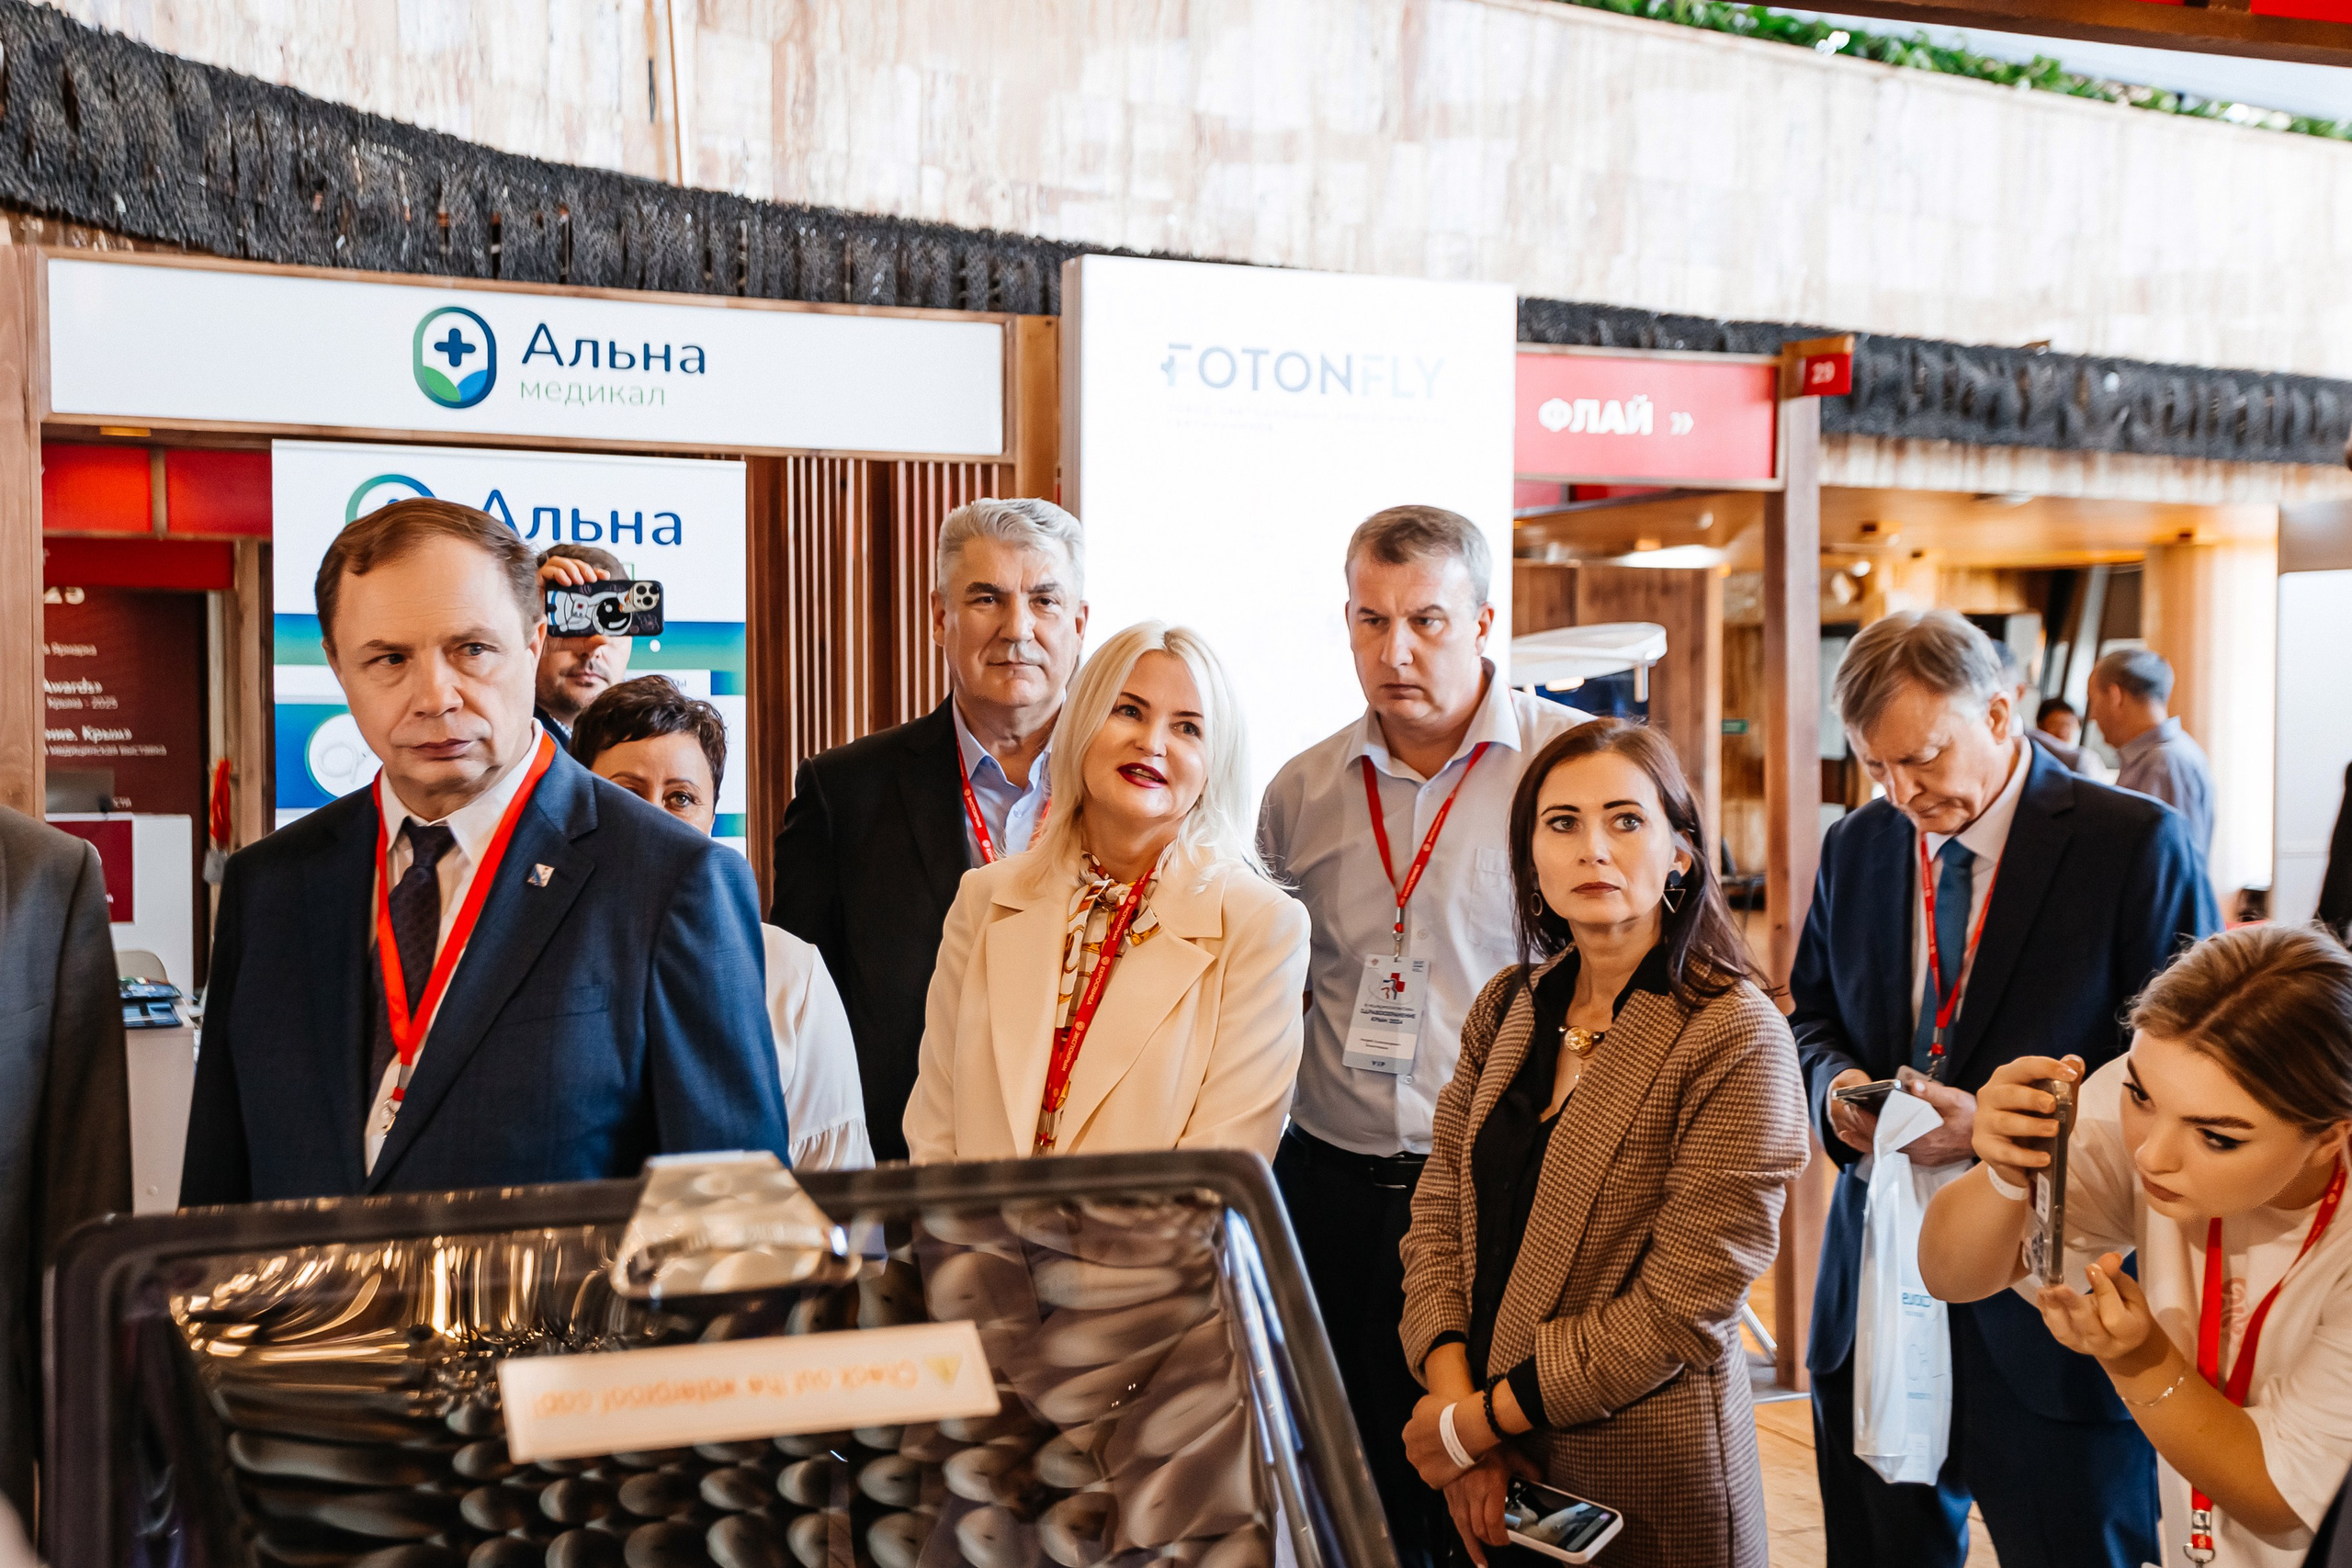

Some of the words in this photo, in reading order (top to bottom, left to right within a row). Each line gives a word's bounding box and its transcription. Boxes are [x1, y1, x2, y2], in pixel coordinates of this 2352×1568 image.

[521, 321, 707, 375] Альна
[1160, 342, 1446, 400] FOTONFLY
[520, 378, 666, 409] медикал
[1811, 361, 1836, 385] 29
[1538, 392, 1655, 435] ФЛАЙ
[482, 488, 682, 546] Альна
